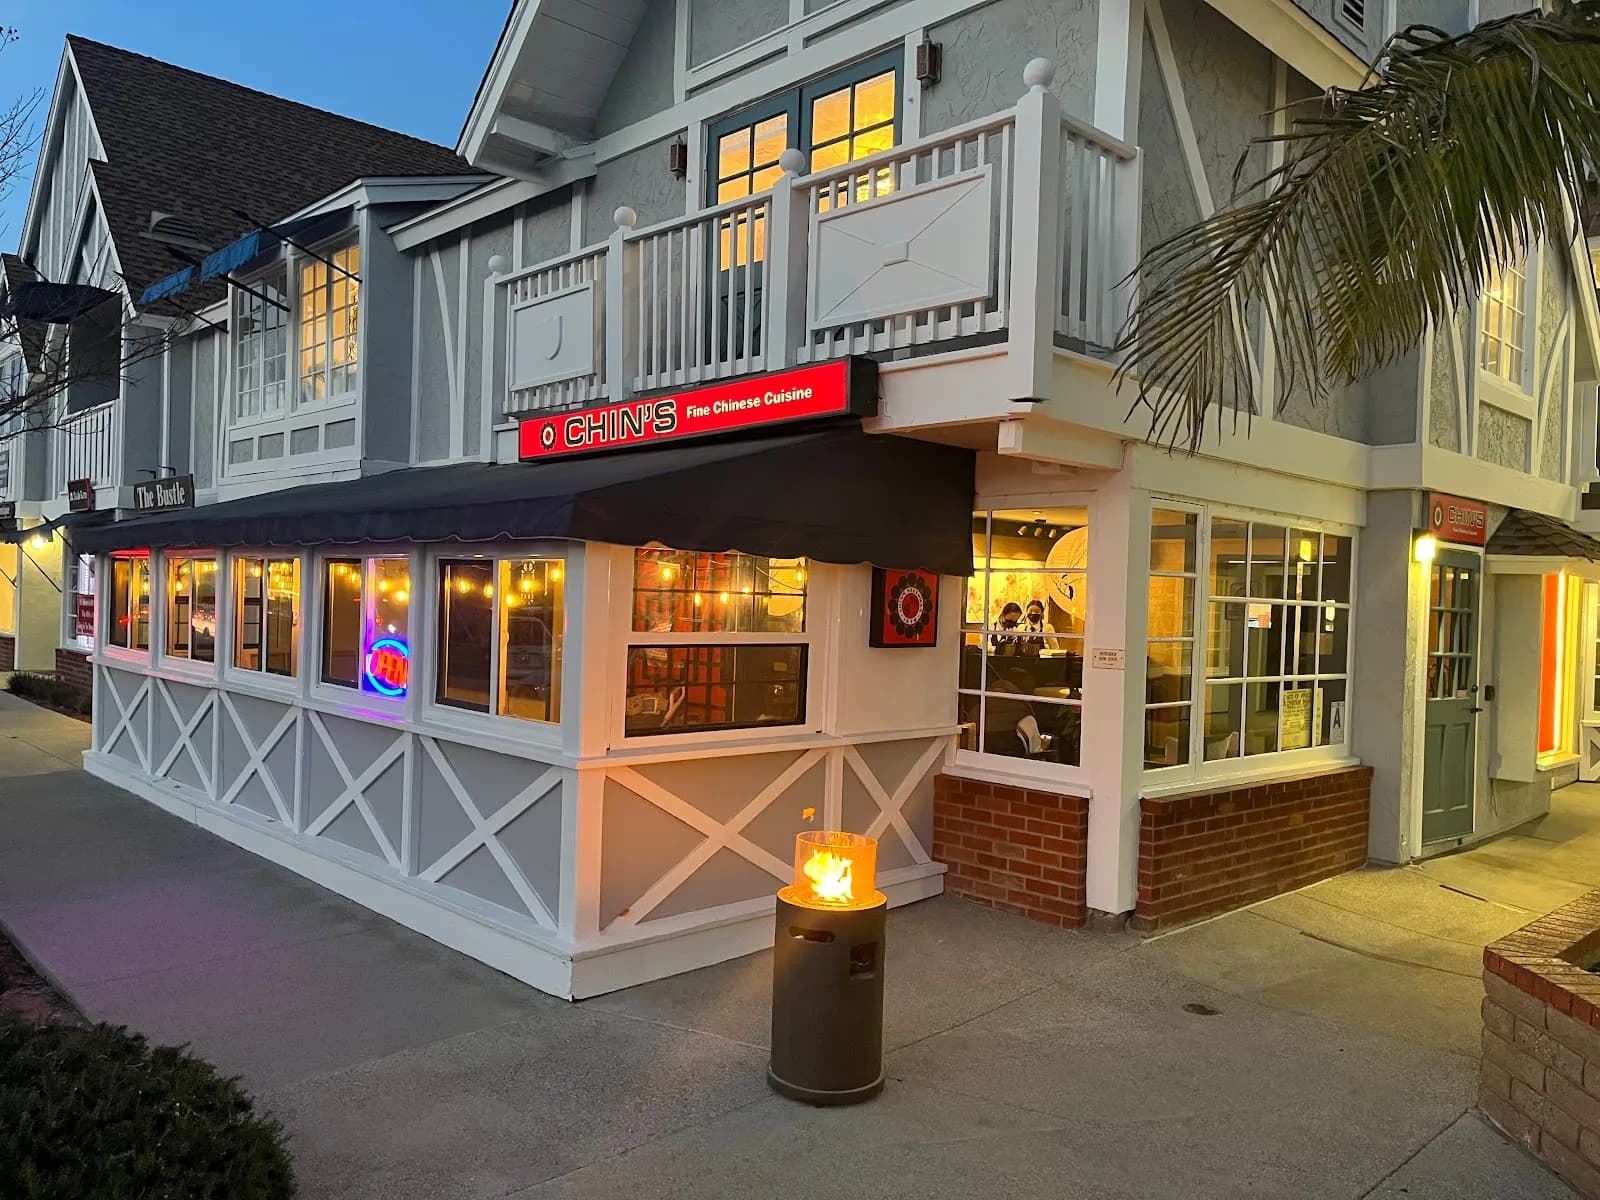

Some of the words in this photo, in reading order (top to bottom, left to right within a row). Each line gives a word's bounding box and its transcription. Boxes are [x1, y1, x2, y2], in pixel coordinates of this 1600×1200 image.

[686, 405, 711, 419] Fine
[713, 397, 760, 415] Chinese
[764, 387, 813, 406] Cuisine
[564, 399, 677, 447] CHIN'S
[136, 486, 154, 509] The
[156, 481, 186, 508] Bustle
[1333, 707, 1341, 728] A
